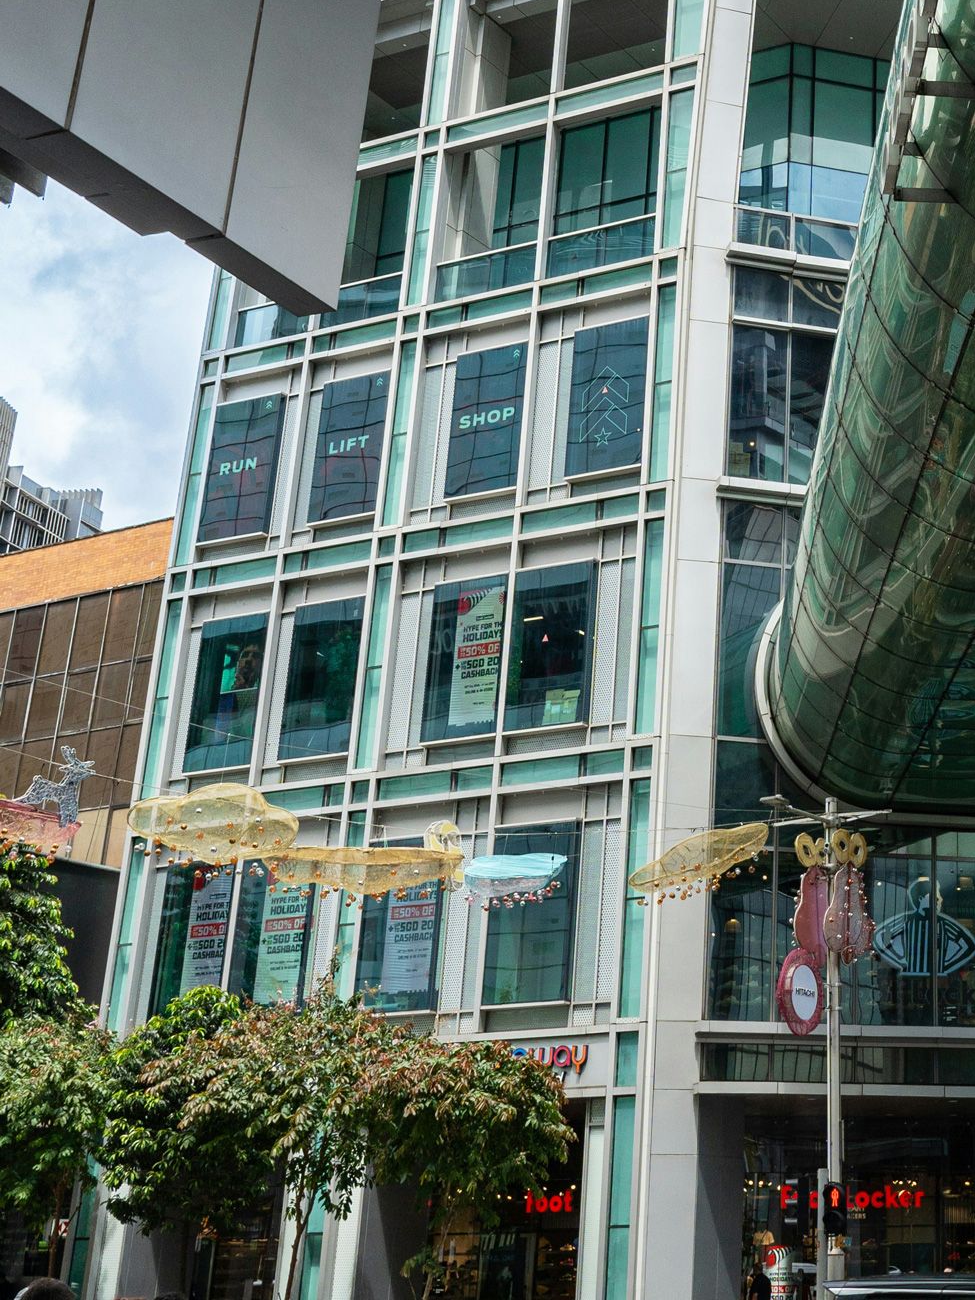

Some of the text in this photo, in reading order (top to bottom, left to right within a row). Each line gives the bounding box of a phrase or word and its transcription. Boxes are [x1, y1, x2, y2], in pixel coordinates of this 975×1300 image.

[459, 406, 515, 429] SHOP
[328, 435, 370, 455] LIFT
[219, 457, 257, 476] RUN
[488, 643, 500, 653] OF
[270, 904, 306, 915] HOLIDAY
[422, 906, 434, 916] OF
[196, 910, 228, 922] HOLIDAY
[267, 944, 302, 954] CASHBAC
[192, 950, 224, 960] CASHBAC
[795, 987, 816, 998] HITACHI
